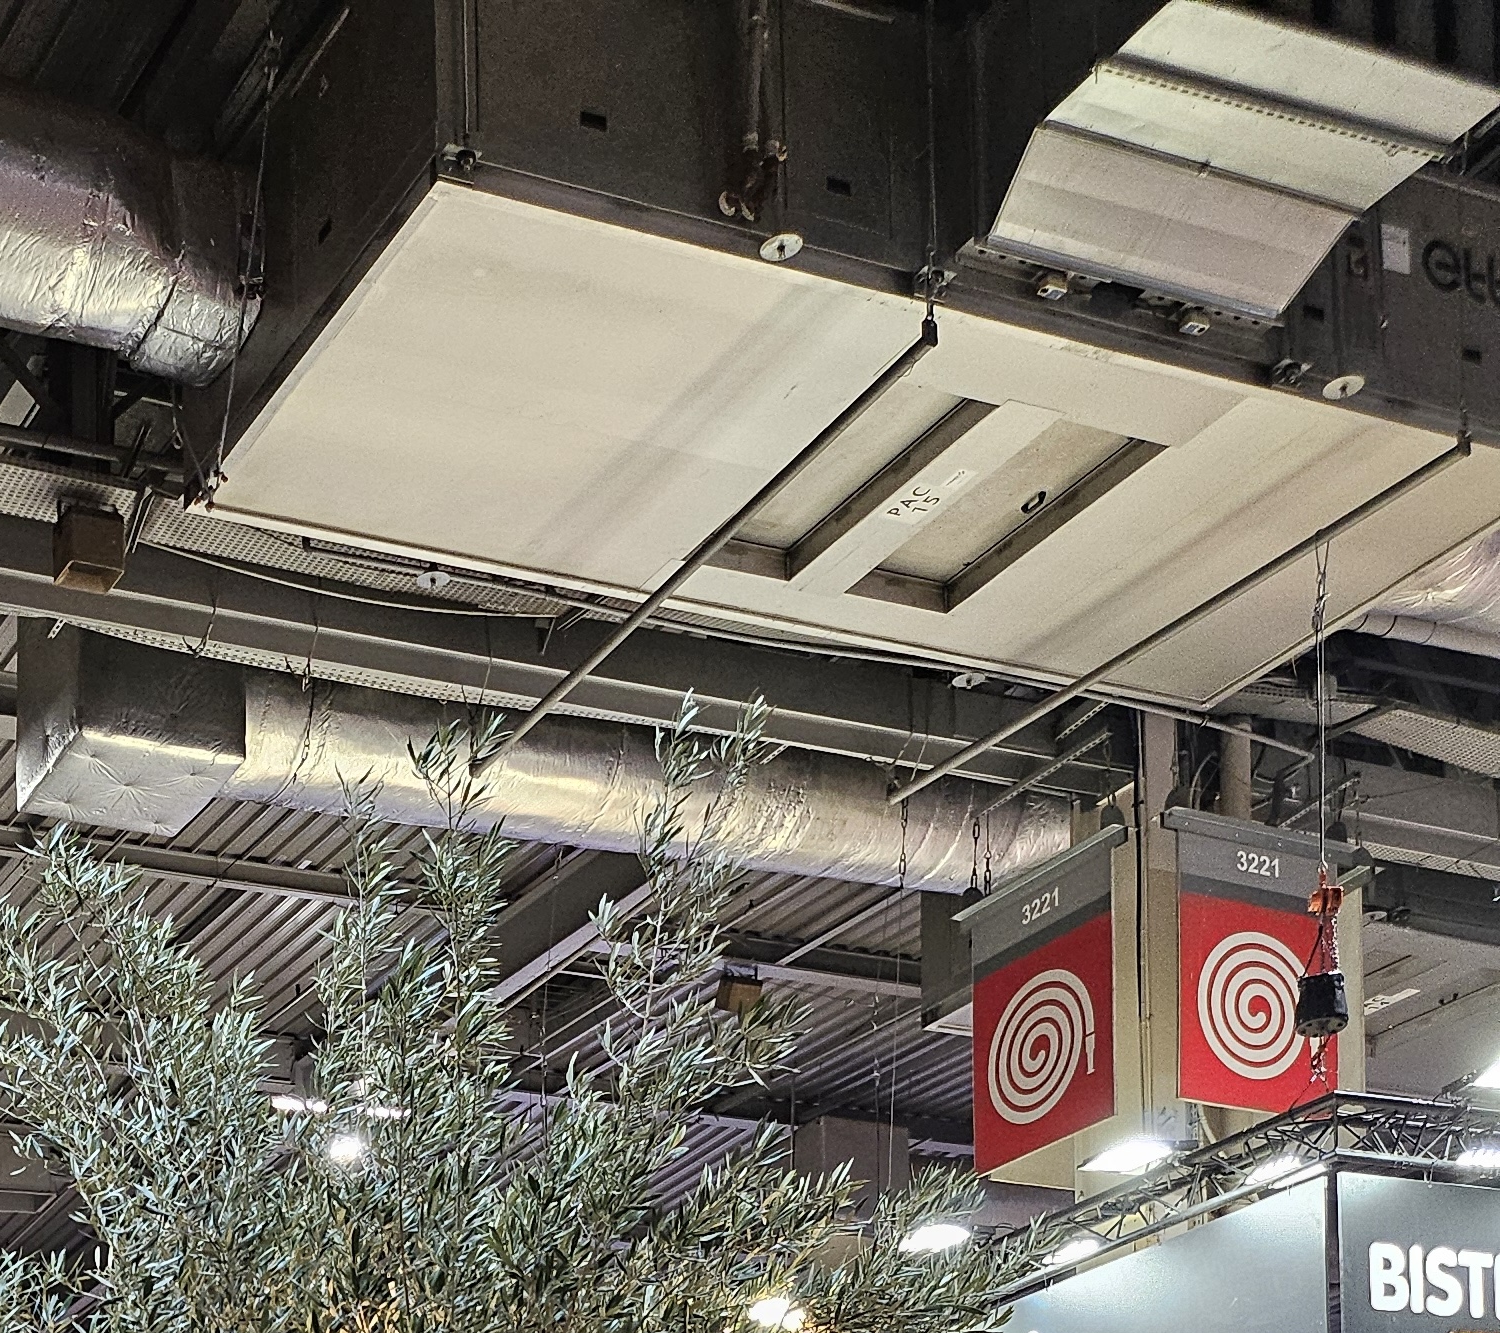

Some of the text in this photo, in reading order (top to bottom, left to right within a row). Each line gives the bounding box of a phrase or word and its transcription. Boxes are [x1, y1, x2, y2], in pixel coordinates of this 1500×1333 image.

[887, 486, 931, 517] PAC
[1236, 850, 1281, 878] 3221
[1021, 886, 1060, 925] 3221
[1367, 1241, 1500, 1321] BIST
